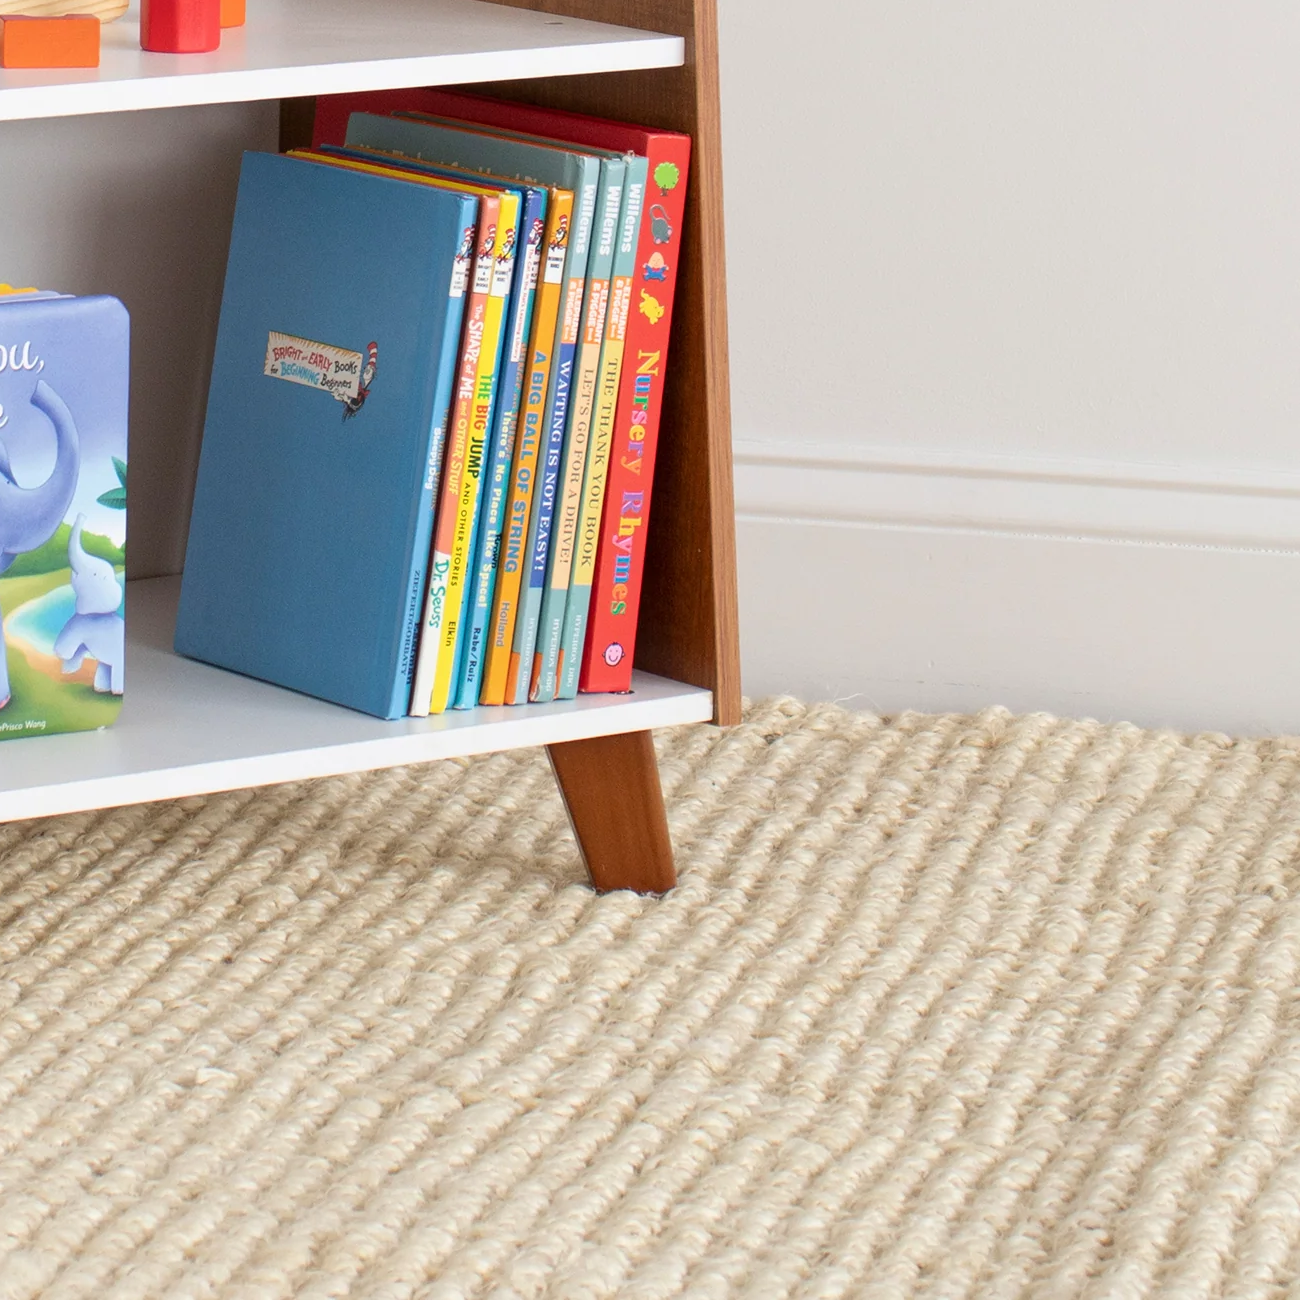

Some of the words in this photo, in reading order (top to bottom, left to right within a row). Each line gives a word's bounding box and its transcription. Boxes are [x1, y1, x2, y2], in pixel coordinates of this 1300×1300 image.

[576, 184, 596, 255] Willems
[599, 185, 621, 256] Willems
[621, 183, 643, 253] Willems
[474, 304, 483, 319] The
[272, 346, 303, 362] BRIGHT
[308, 352, 333, 372] EARLY
[464, 319, 484, 364] SHAPE
[534, 351, 547, 364] A
[280, 361, 320, 385] BEGINNING
[320, 373, 352, 390] Beginners
[459, 376, 476, 399] ME
[464, 364, 474, 375] of
[476, 374, 494, 400] THE
[604, 358, 618, 397] THE
[528, 372, 545, 405] BIG
[552, 360, 571, 443] WAITING
[579, 369, 594, 416] LET'S
[474, 404, 489, 430] BIG
[621, 350, 661, 476] Nursery
[428, 427, 441, 466] Sleepy
[452, 418, 468, 459] OTHER
[498, 411, 513, 458] There's
[520, 412, 539, 461] BALL
[575, 421, 587, 444] GO
[594, 402, 612, 465] THANK
[467, 436, 486, 479] JUMP
[495, 464, 505, 482] No
[547, 449, 560, 466] IS
[570, 450, 583, 483] FOR
[425, 464, 436, 489] Dog
[449, 460, 463, 495] STUFF
[461, 483, 471, 505] AND
[517, 468, 531, 493] OF
[542, 472, 556, 510] NOT
[568, 489, 577, 500] A
[588, 474, 603, 510] YOU
[489, 489, 502, 524] Place
[458, 509, 468, 541] OTHER
[504, 501, 526, 573] STRING
[559, 506, 576, 564] DRIVE!
[581, 515, 597, 568] BOOK
[483, 530, 497, 558] Like
[534, 516, 550, 572] EASY!
[610, 490, 645, 615] Rhymes
[434, 559, 449, 581] Dr.
[451, 547, 463, 587] STORIES
[429, 585, 446, 628] Seuss
[496, 602, 510, 647] Holland
[446, 621, 457, 647] Elkin
[467, 627, 481, 682] Rabe/Ruiz
[25, 720, 46, 730] Wang
